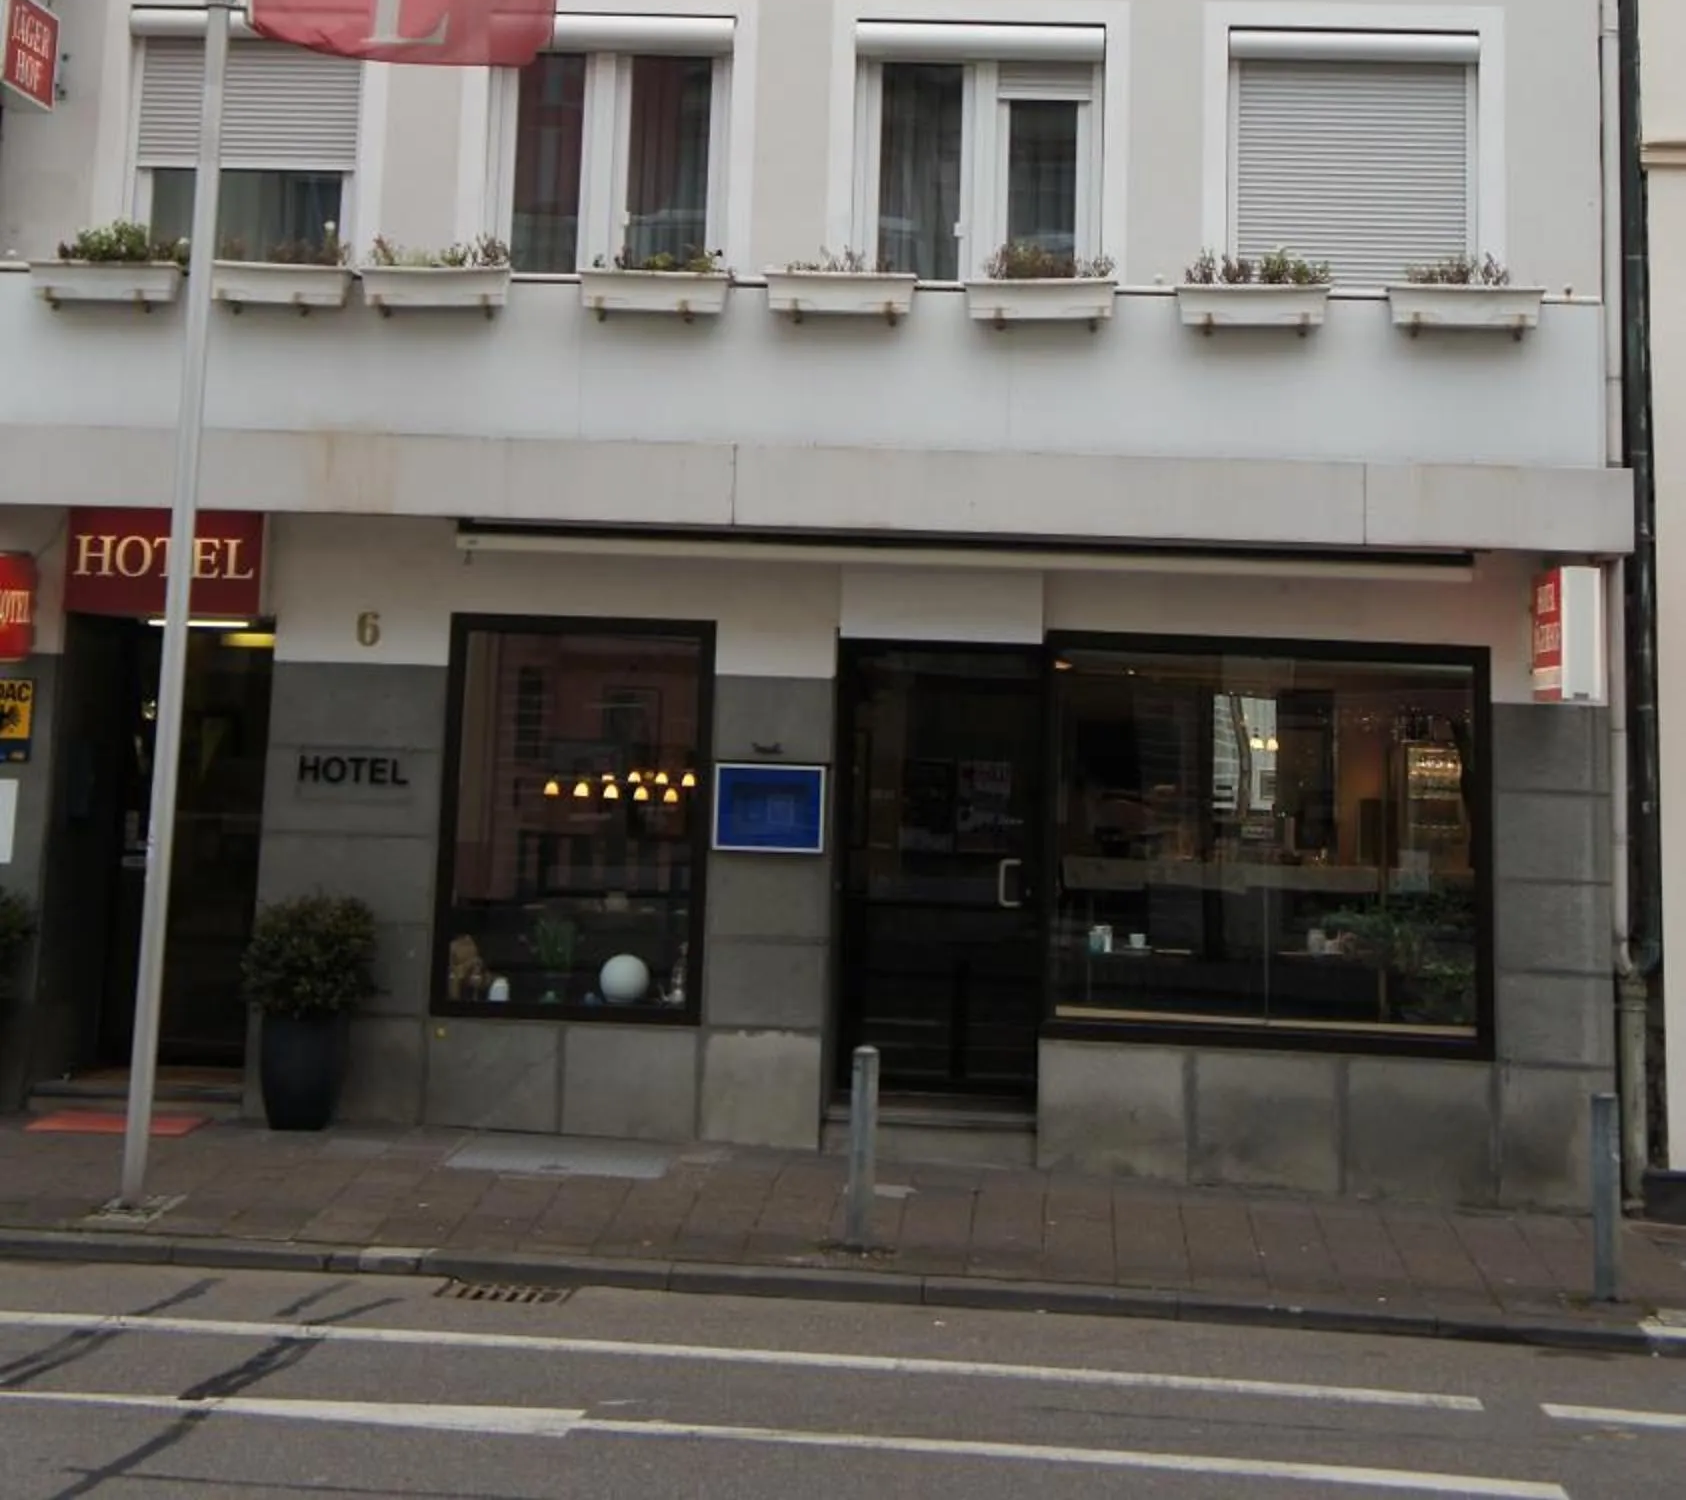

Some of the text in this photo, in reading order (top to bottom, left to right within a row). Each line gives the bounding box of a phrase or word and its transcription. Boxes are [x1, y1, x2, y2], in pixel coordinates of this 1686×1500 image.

[11, 4, 50, 60] JÄGER
[15, 48, 43, 94] HOF
[0, 589, 31, 624] OTEL
[356, 611, 381, 647] 6
[297, 754, 410, 786] HOTEL
